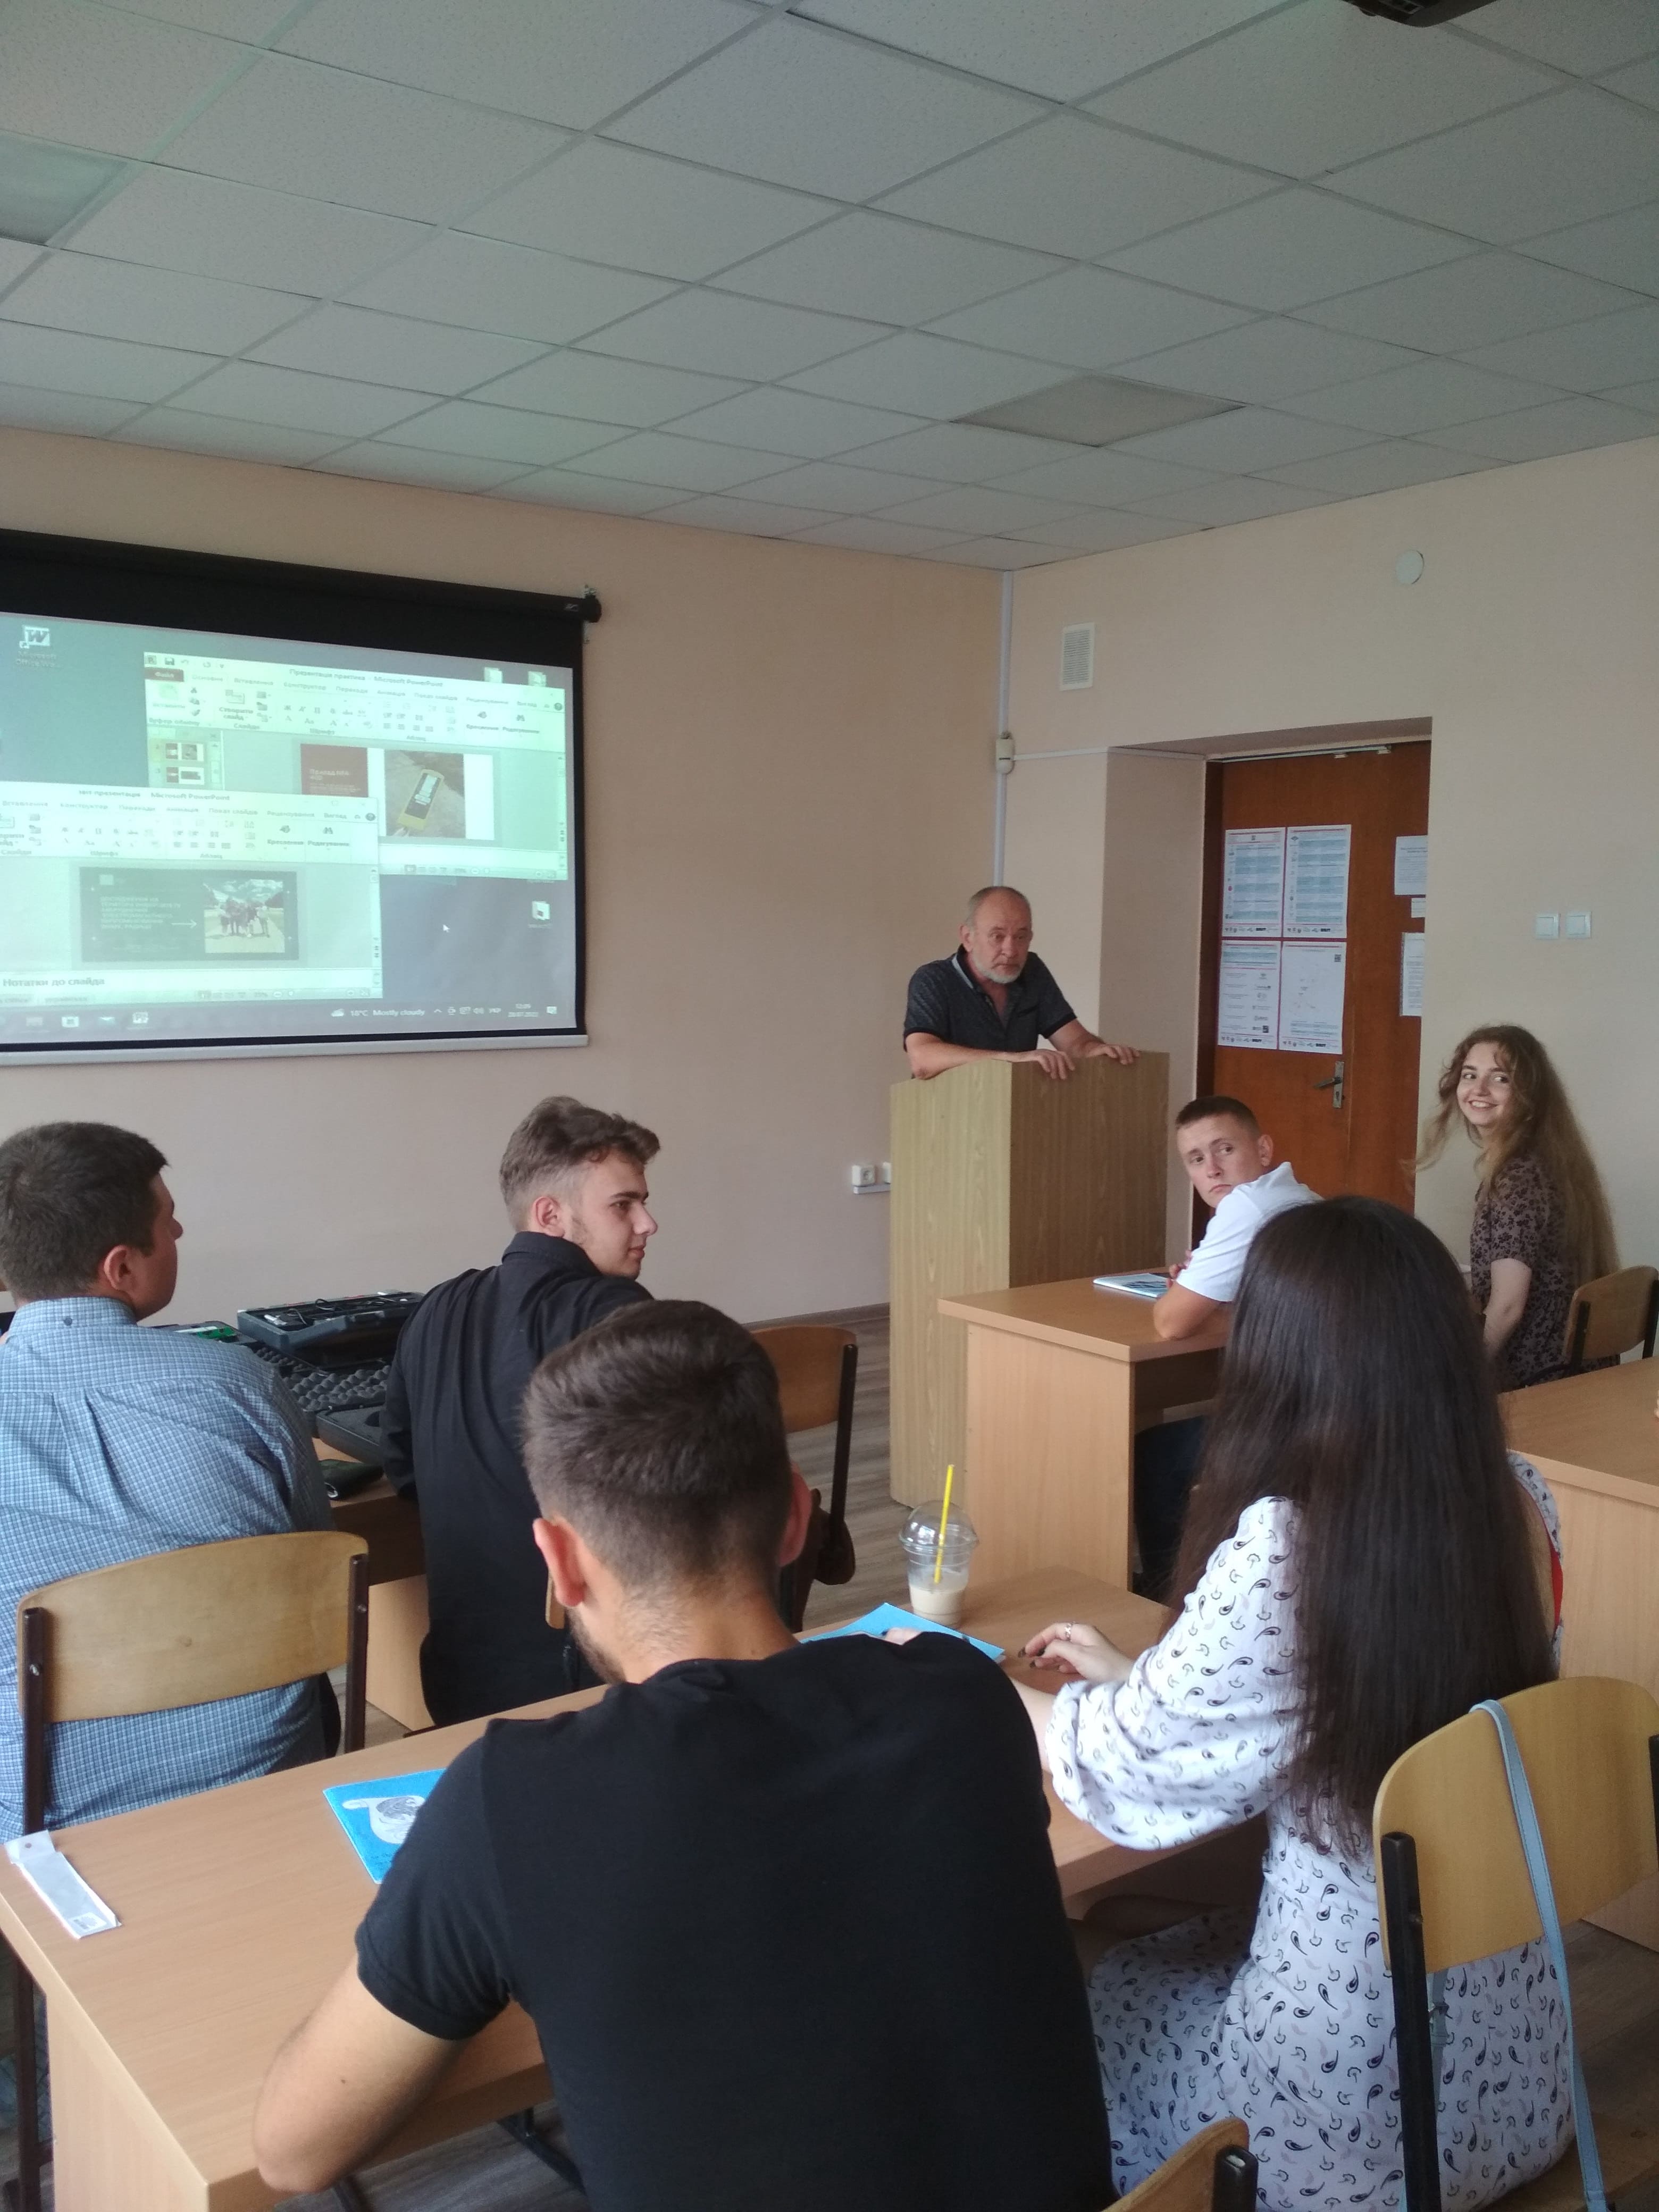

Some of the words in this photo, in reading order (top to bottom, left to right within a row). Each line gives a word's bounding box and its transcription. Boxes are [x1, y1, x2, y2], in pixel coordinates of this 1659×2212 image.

[406, 679, 443, 688] PowerPoint
[3, 978, 49, 987] Нотатки
[68, 977, 105, 986] слайда
